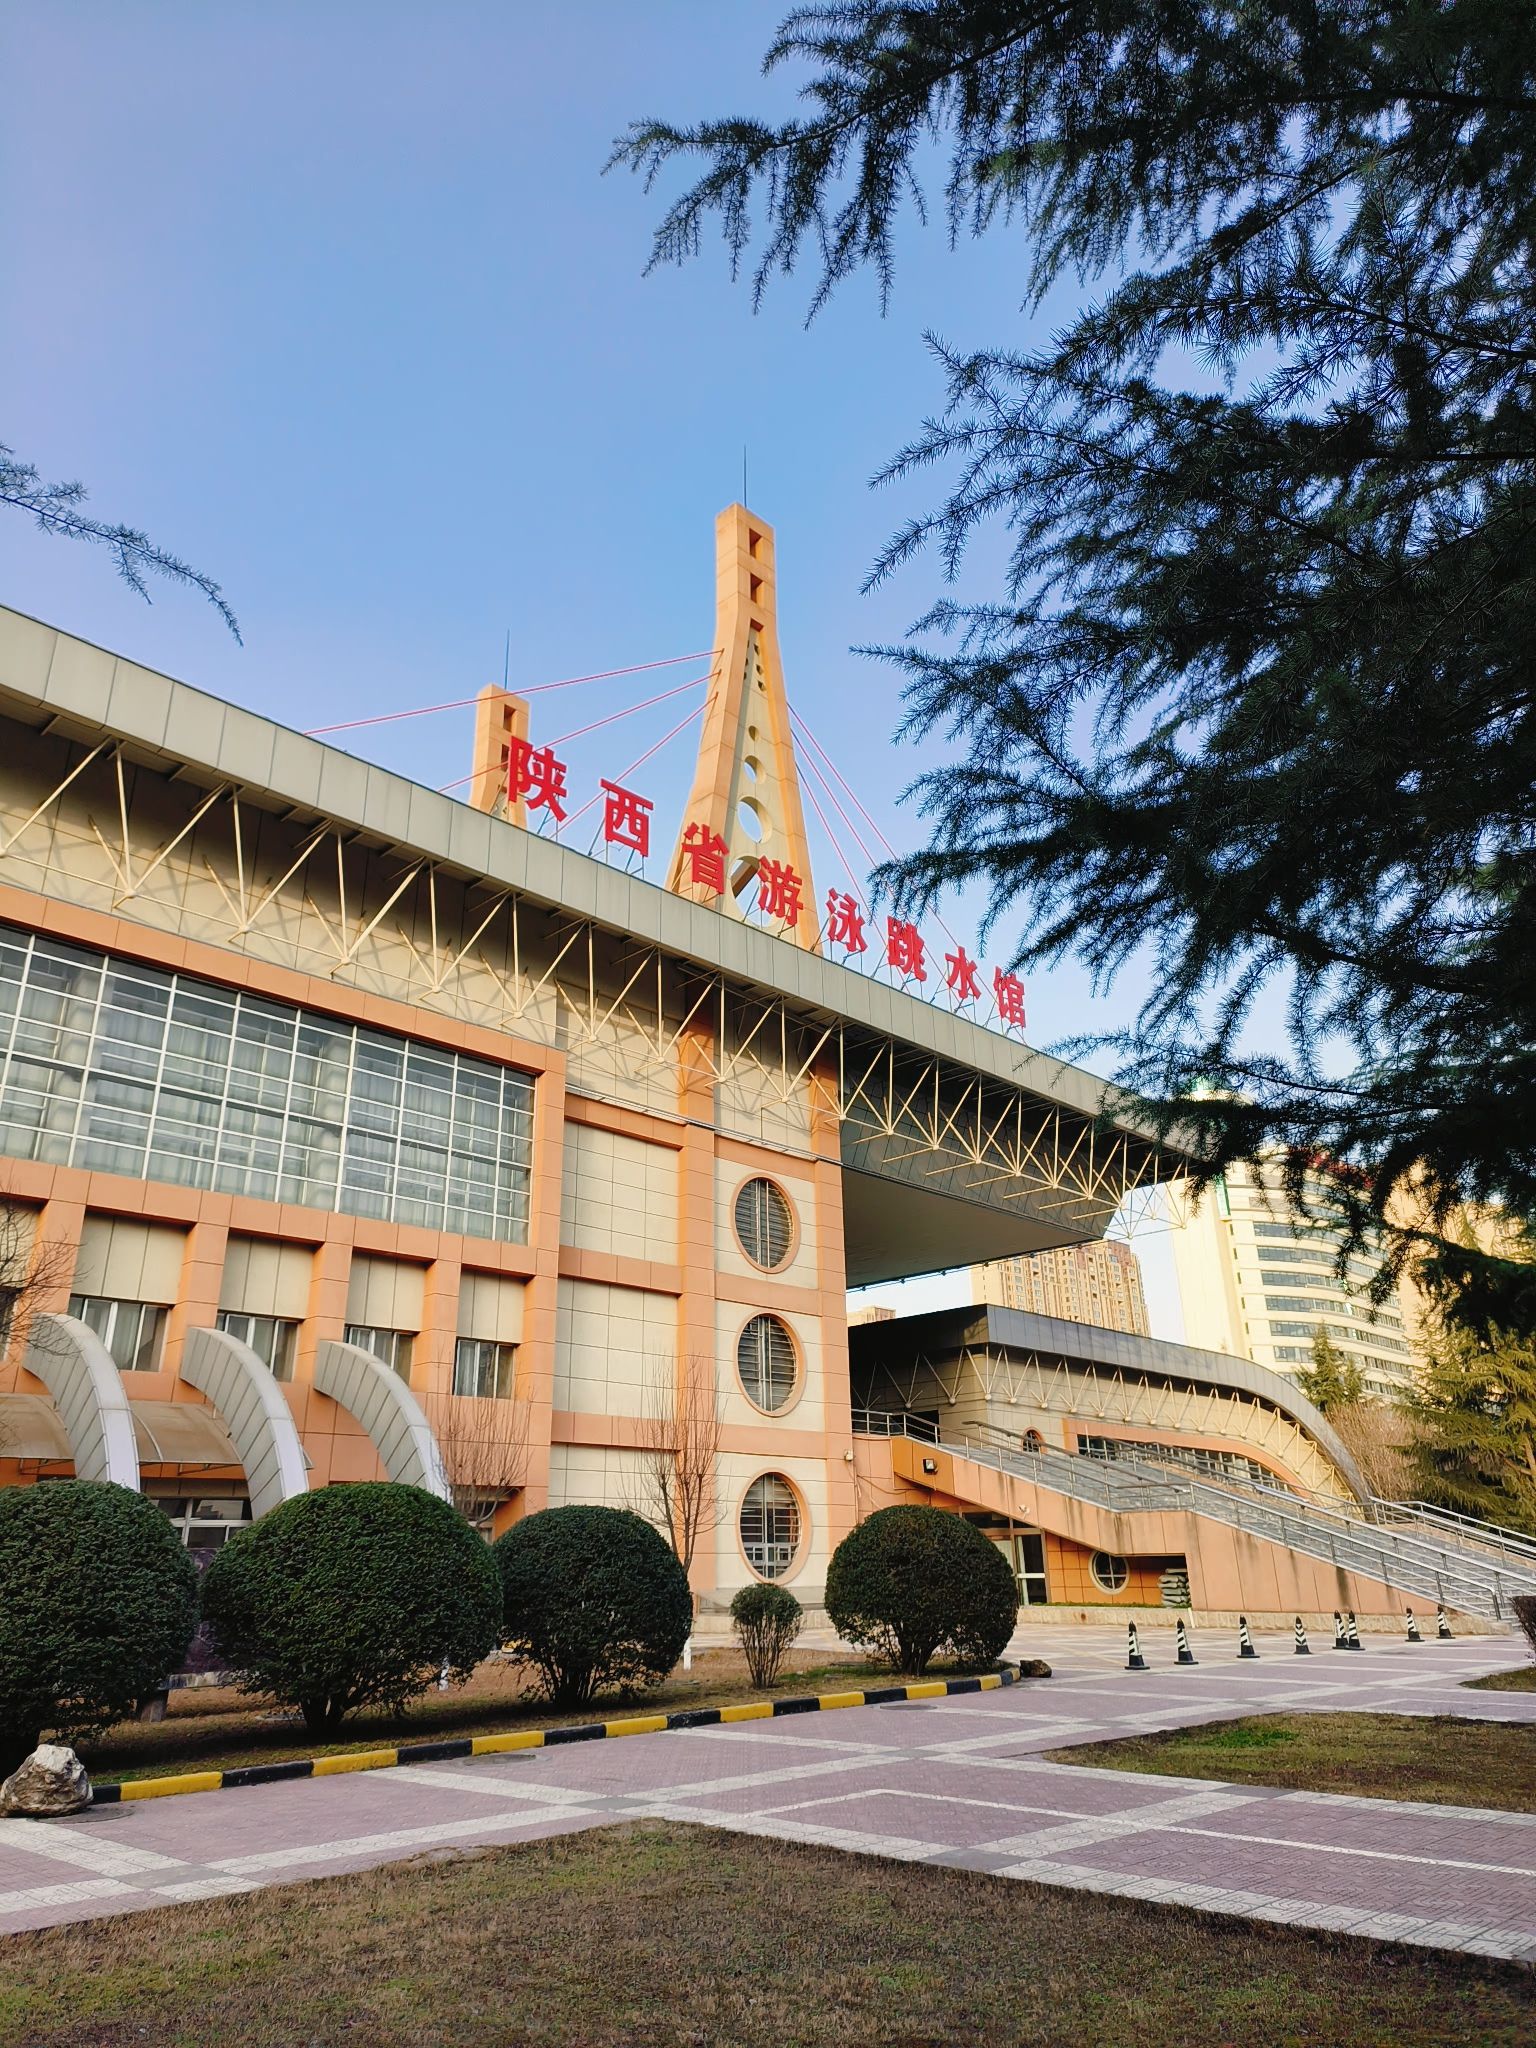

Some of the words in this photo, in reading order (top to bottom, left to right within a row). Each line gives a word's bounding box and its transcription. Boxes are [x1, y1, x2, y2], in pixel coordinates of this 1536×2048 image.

[508, 736, 1027, 1028] 陕西省游泳跳水馆
